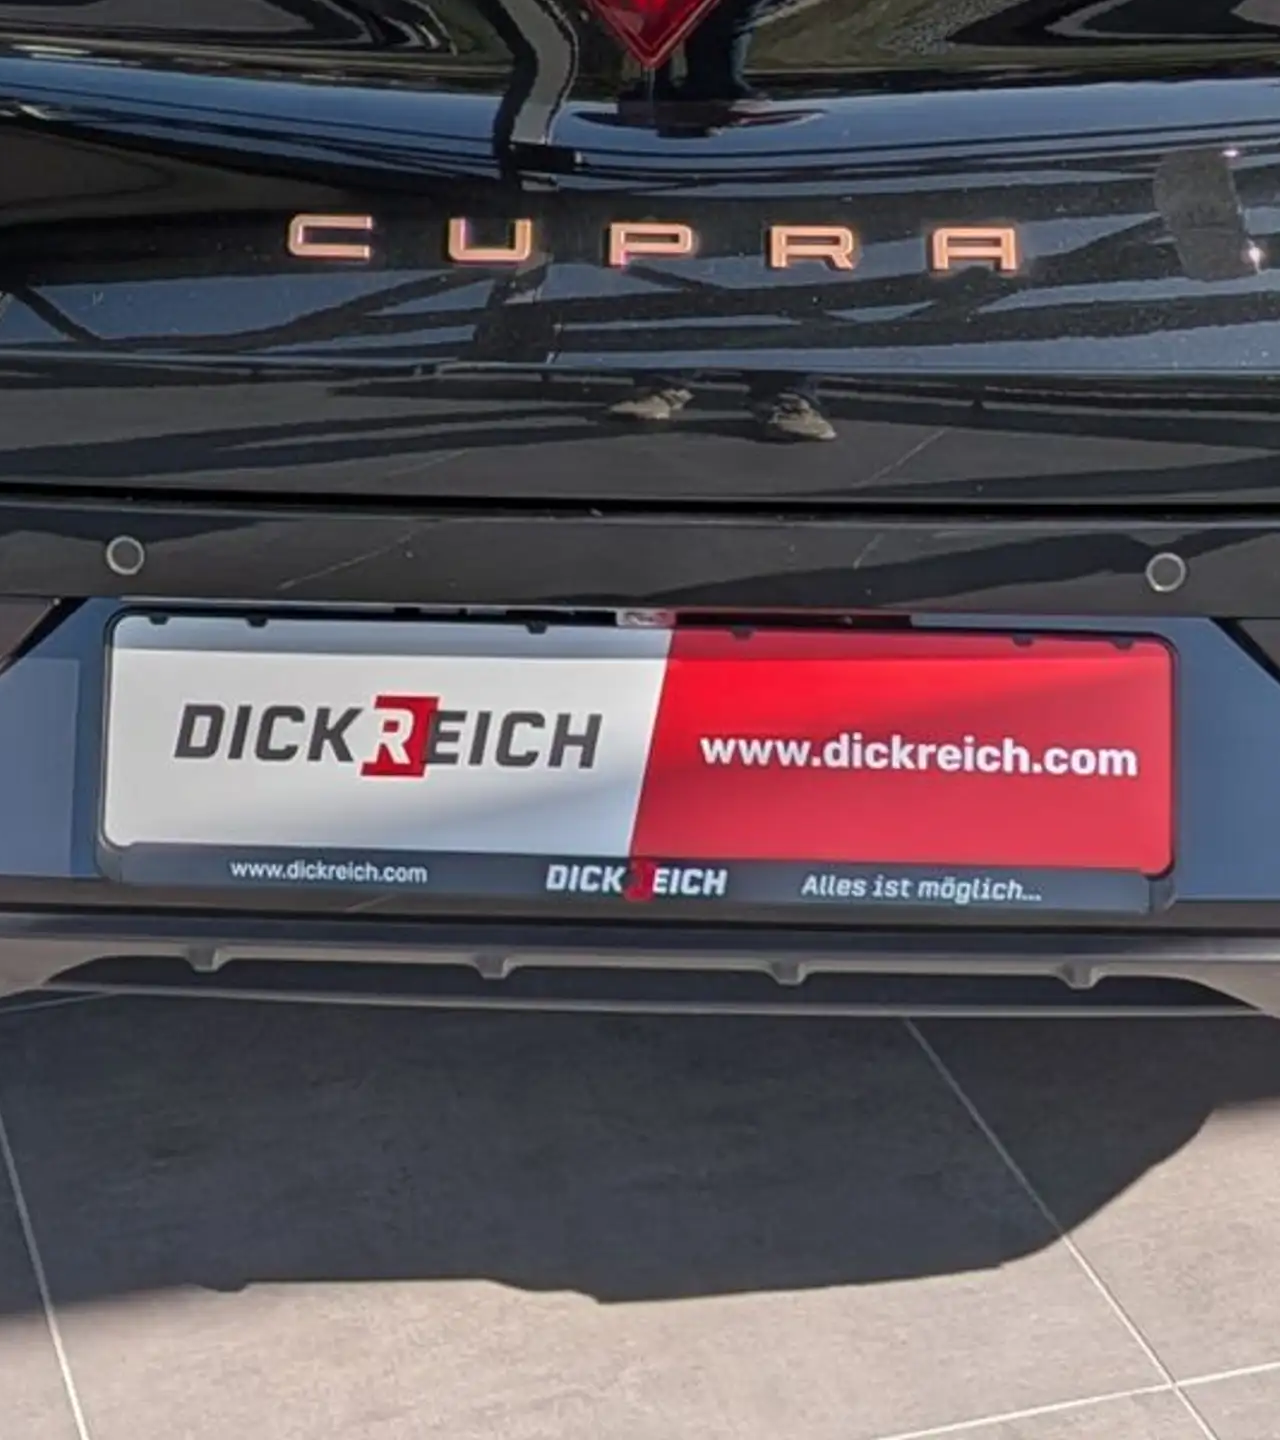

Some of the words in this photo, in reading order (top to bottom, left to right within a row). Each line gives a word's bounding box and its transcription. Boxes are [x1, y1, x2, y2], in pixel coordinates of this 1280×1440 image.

[287, 214, 1018, 271] CUPRA
[174, 698, 603, 771] DICKREICH
[699, 732, 1139, 777] www.dickreich.com
[230, 860, 428, 884] www.dickreich.com
[801, 874, 867, 898] Alles
[872, 875, 911, 899] ist
[918, 876, 1043, 905] möglich...
